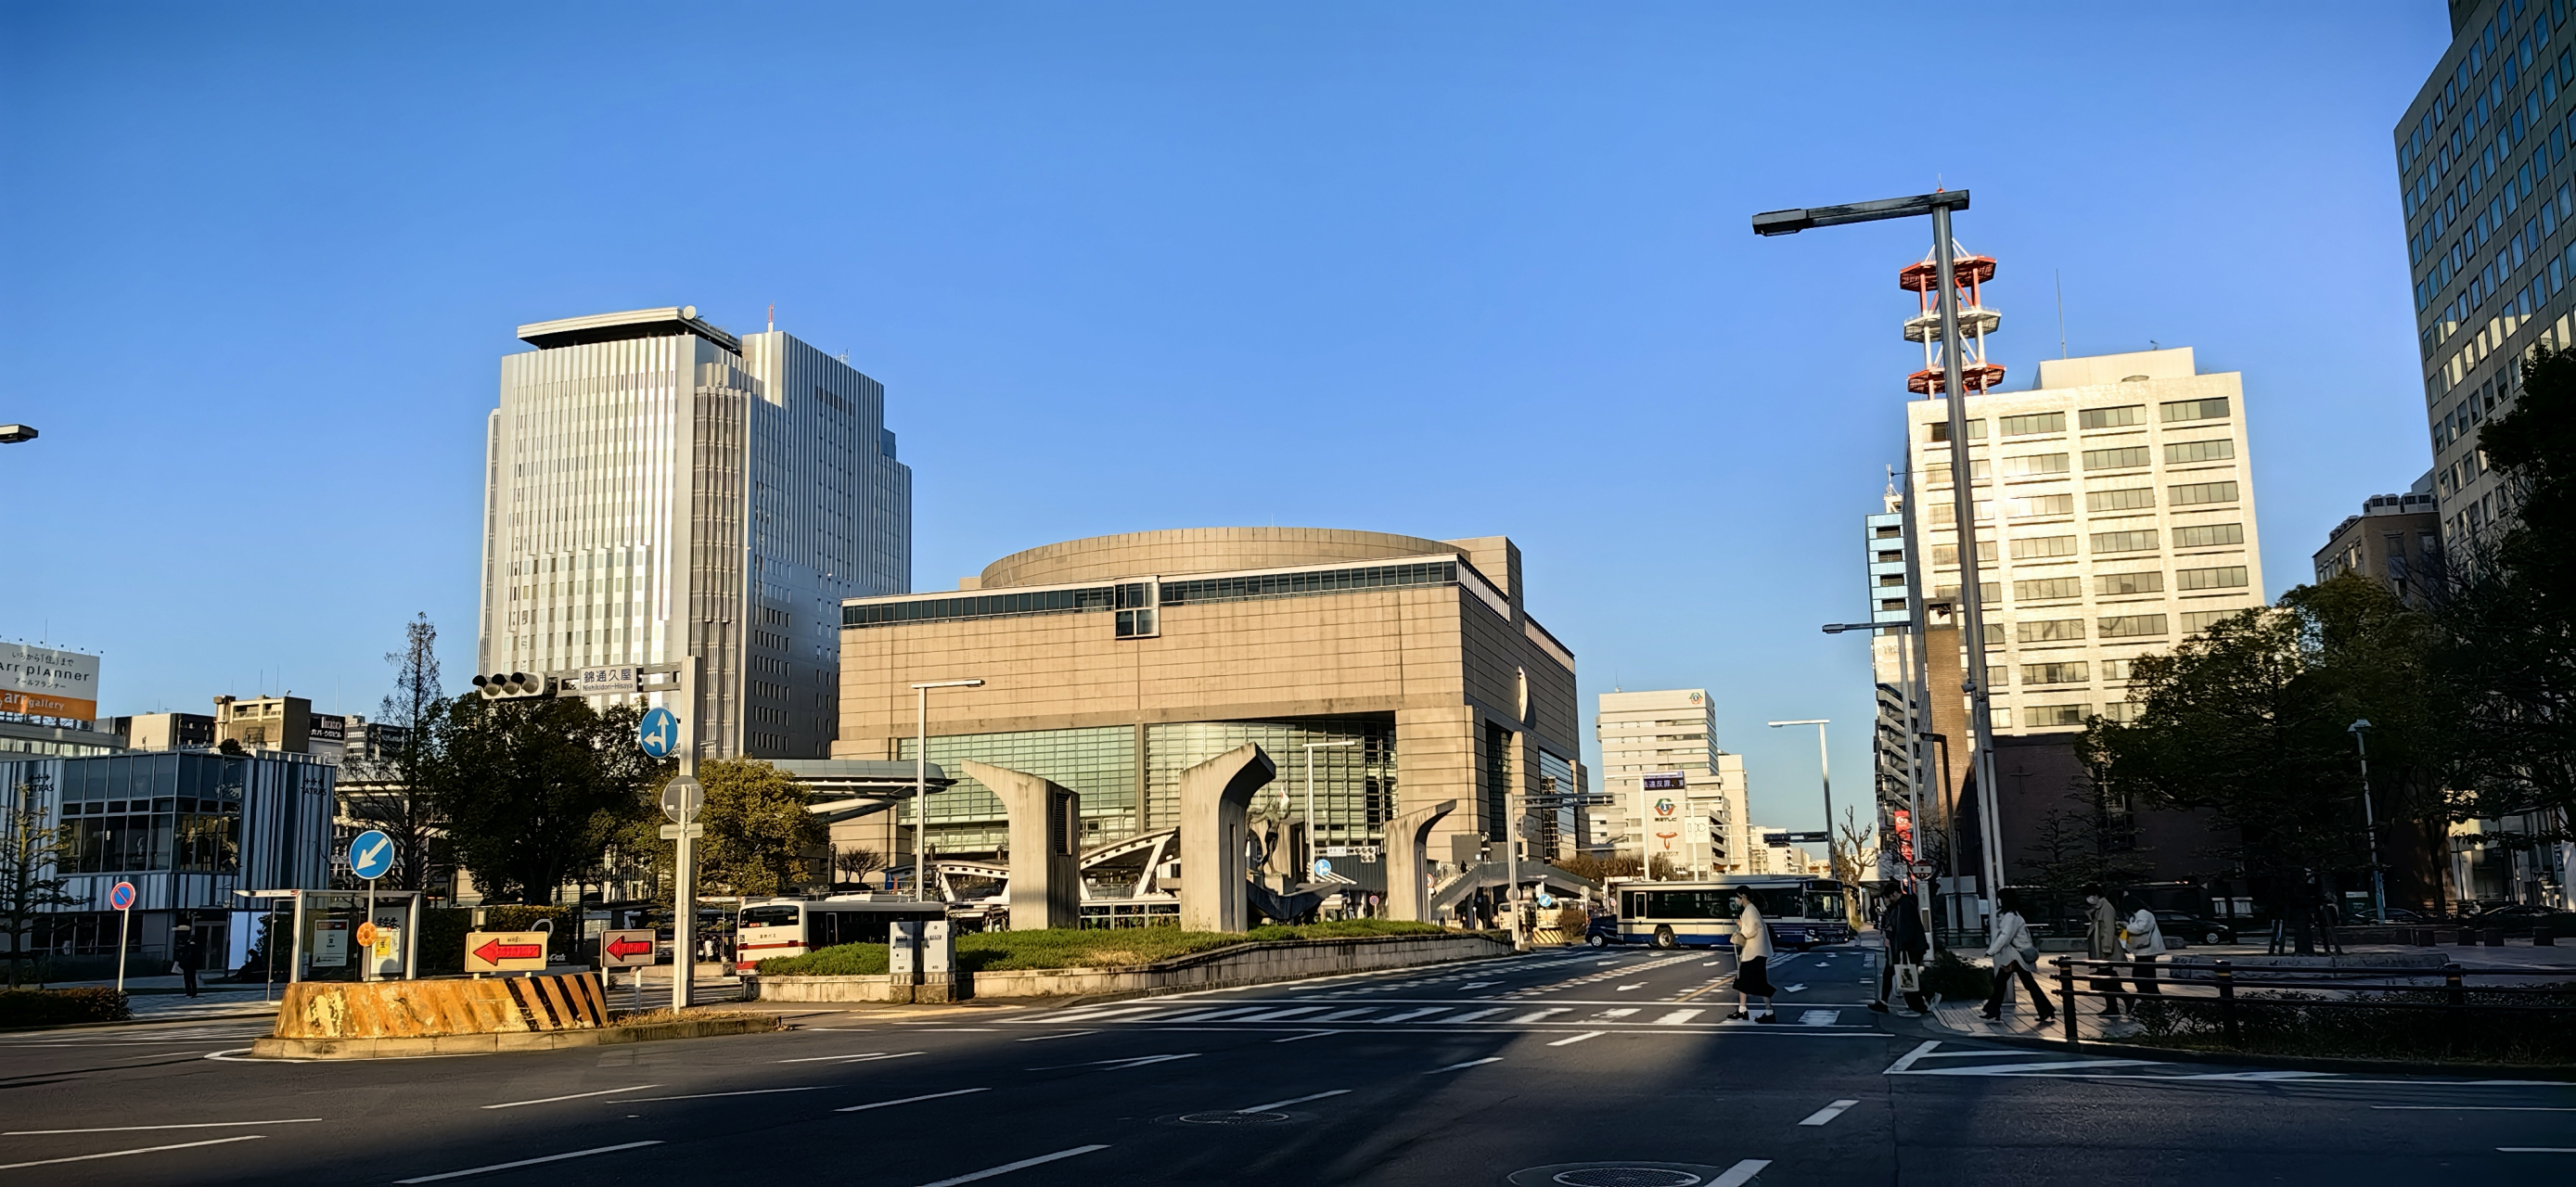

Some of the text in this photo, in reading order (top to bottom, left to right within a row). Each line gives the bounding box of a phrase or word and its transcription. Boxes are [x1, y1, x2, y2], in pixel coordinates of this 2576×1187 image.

[583, 669, 632, 683] 錦通久屋
[28, 698, 65, 711] gallery
